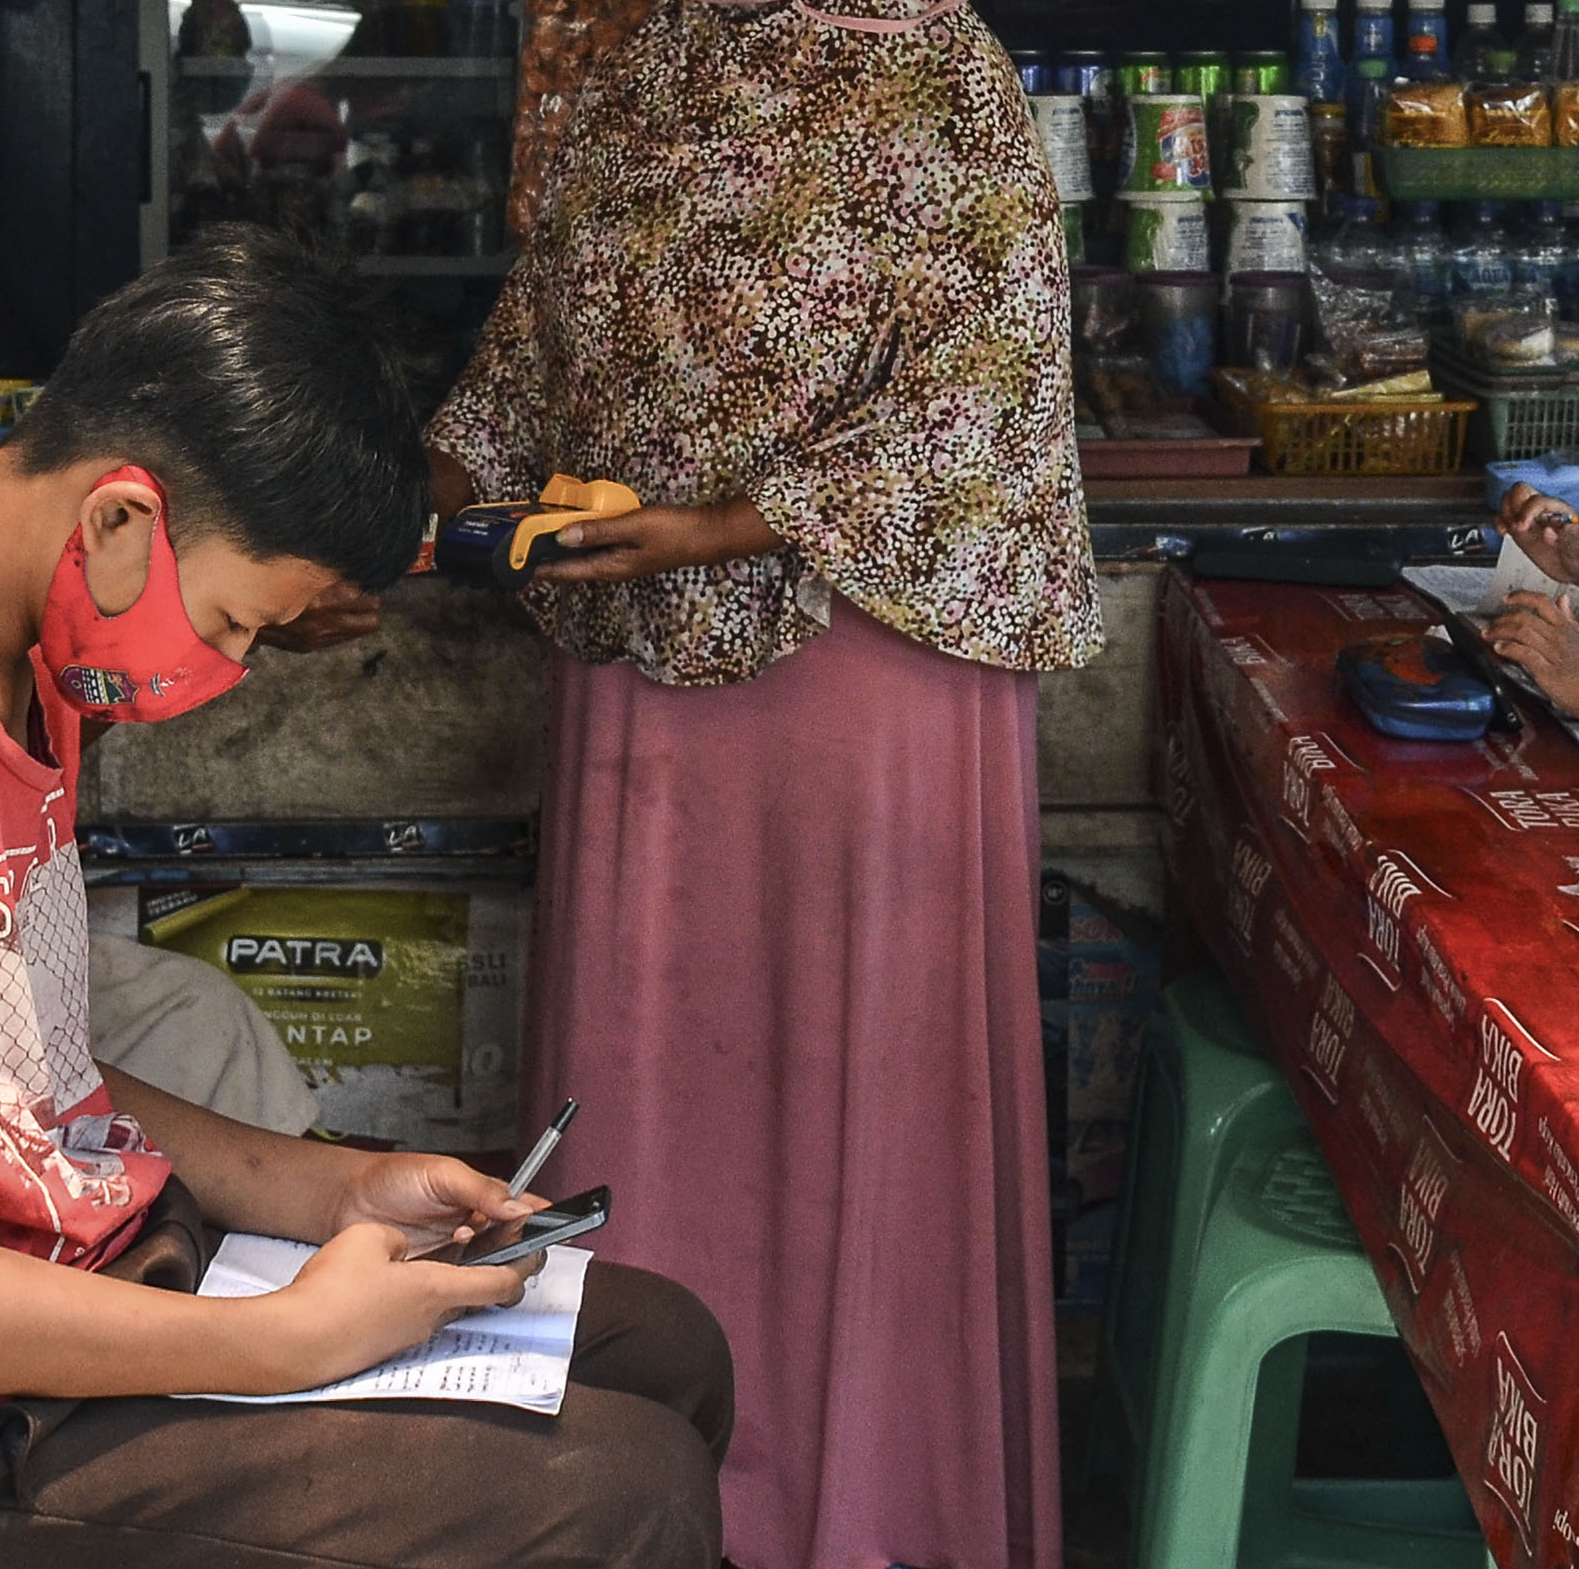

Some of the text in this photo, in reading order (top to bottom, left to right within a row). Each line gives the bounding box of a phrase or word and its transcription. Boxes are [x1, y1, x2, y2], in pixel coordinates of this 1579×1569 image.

[1490, 790, 1559, 830] TORA
[229, 937, 378, 968] PATRA
[286, 1024, 373, 1046] NTAP
[1481, 1015, 1523, 1103] BIKA
[1467, 1067, 1517, 1162] TORA
